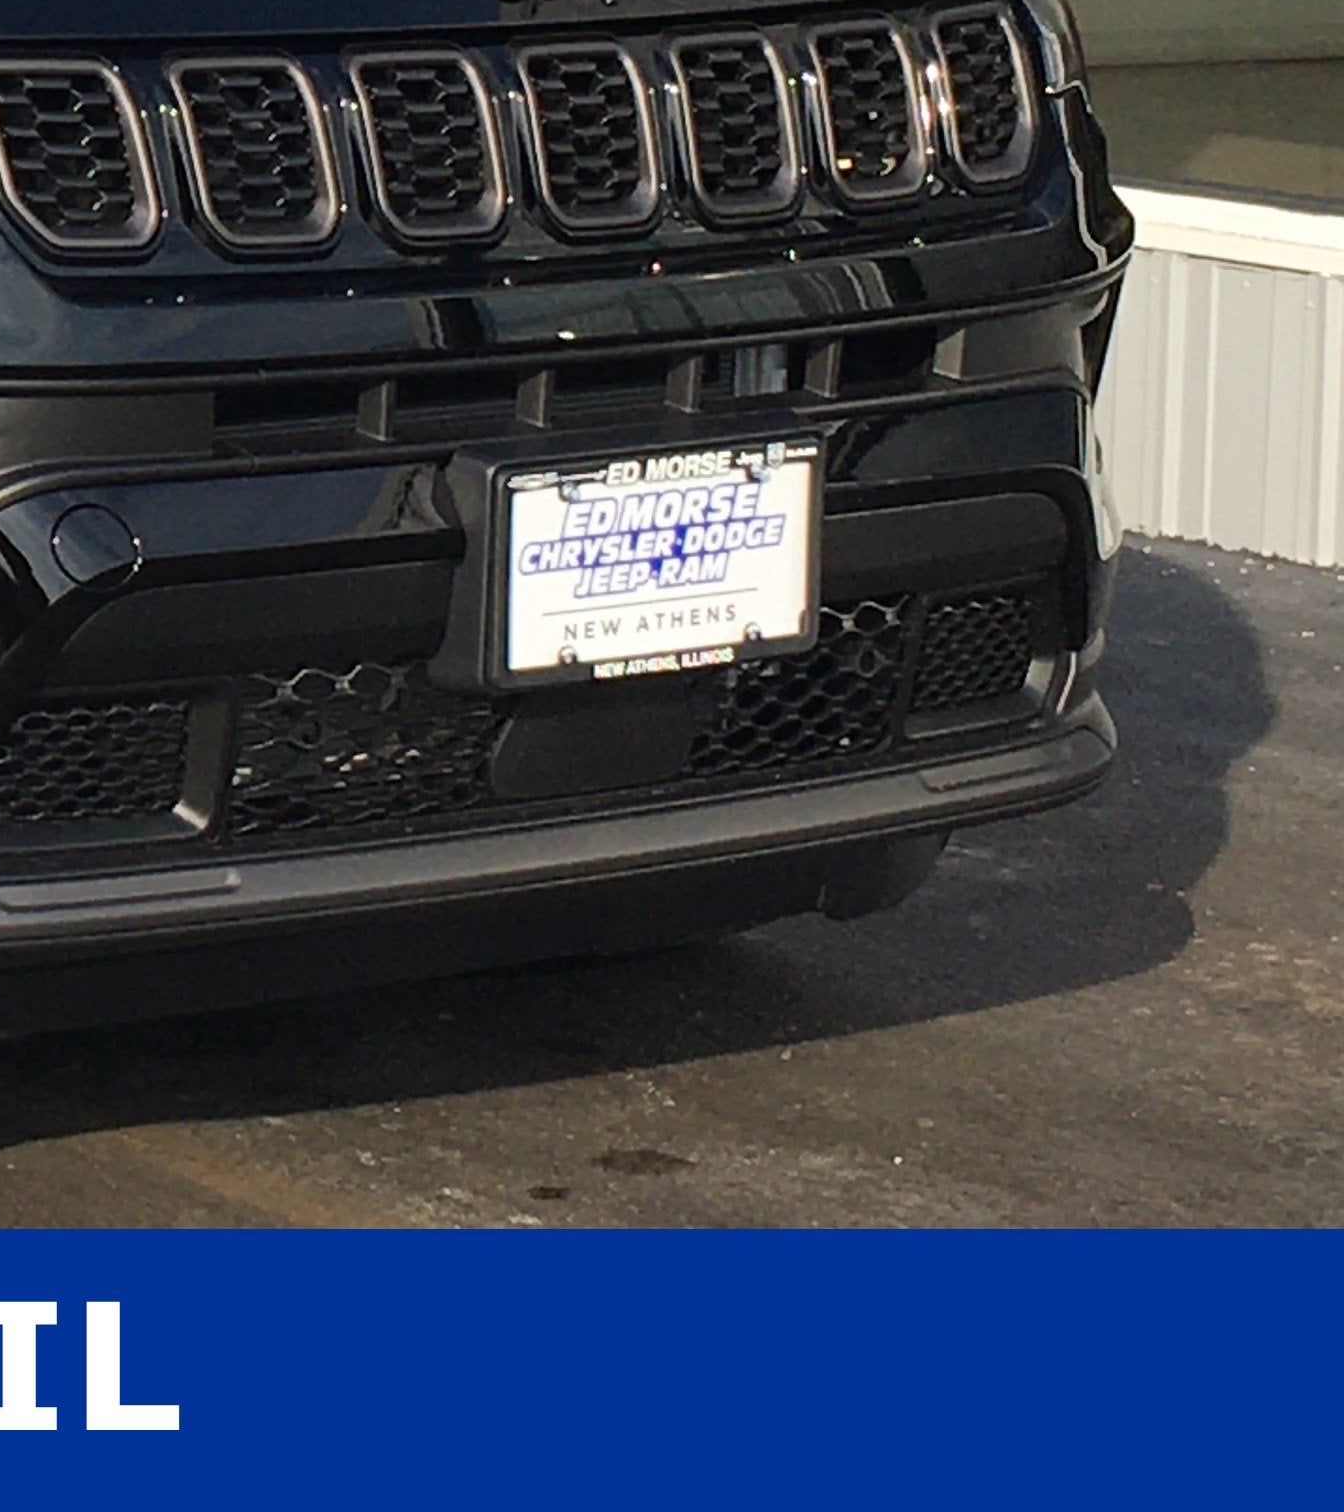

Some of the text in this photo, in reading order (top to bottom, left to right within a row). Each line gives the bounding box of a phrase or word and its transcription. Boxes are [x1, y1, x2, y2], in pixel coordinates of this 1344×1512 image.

[605, 459, 640, 486] ED
[644, 450, 732, 482] MORSE
[561, 484, 760, 540] ED MORSE
[563, 604, 738, 641] NEW ATHENS
